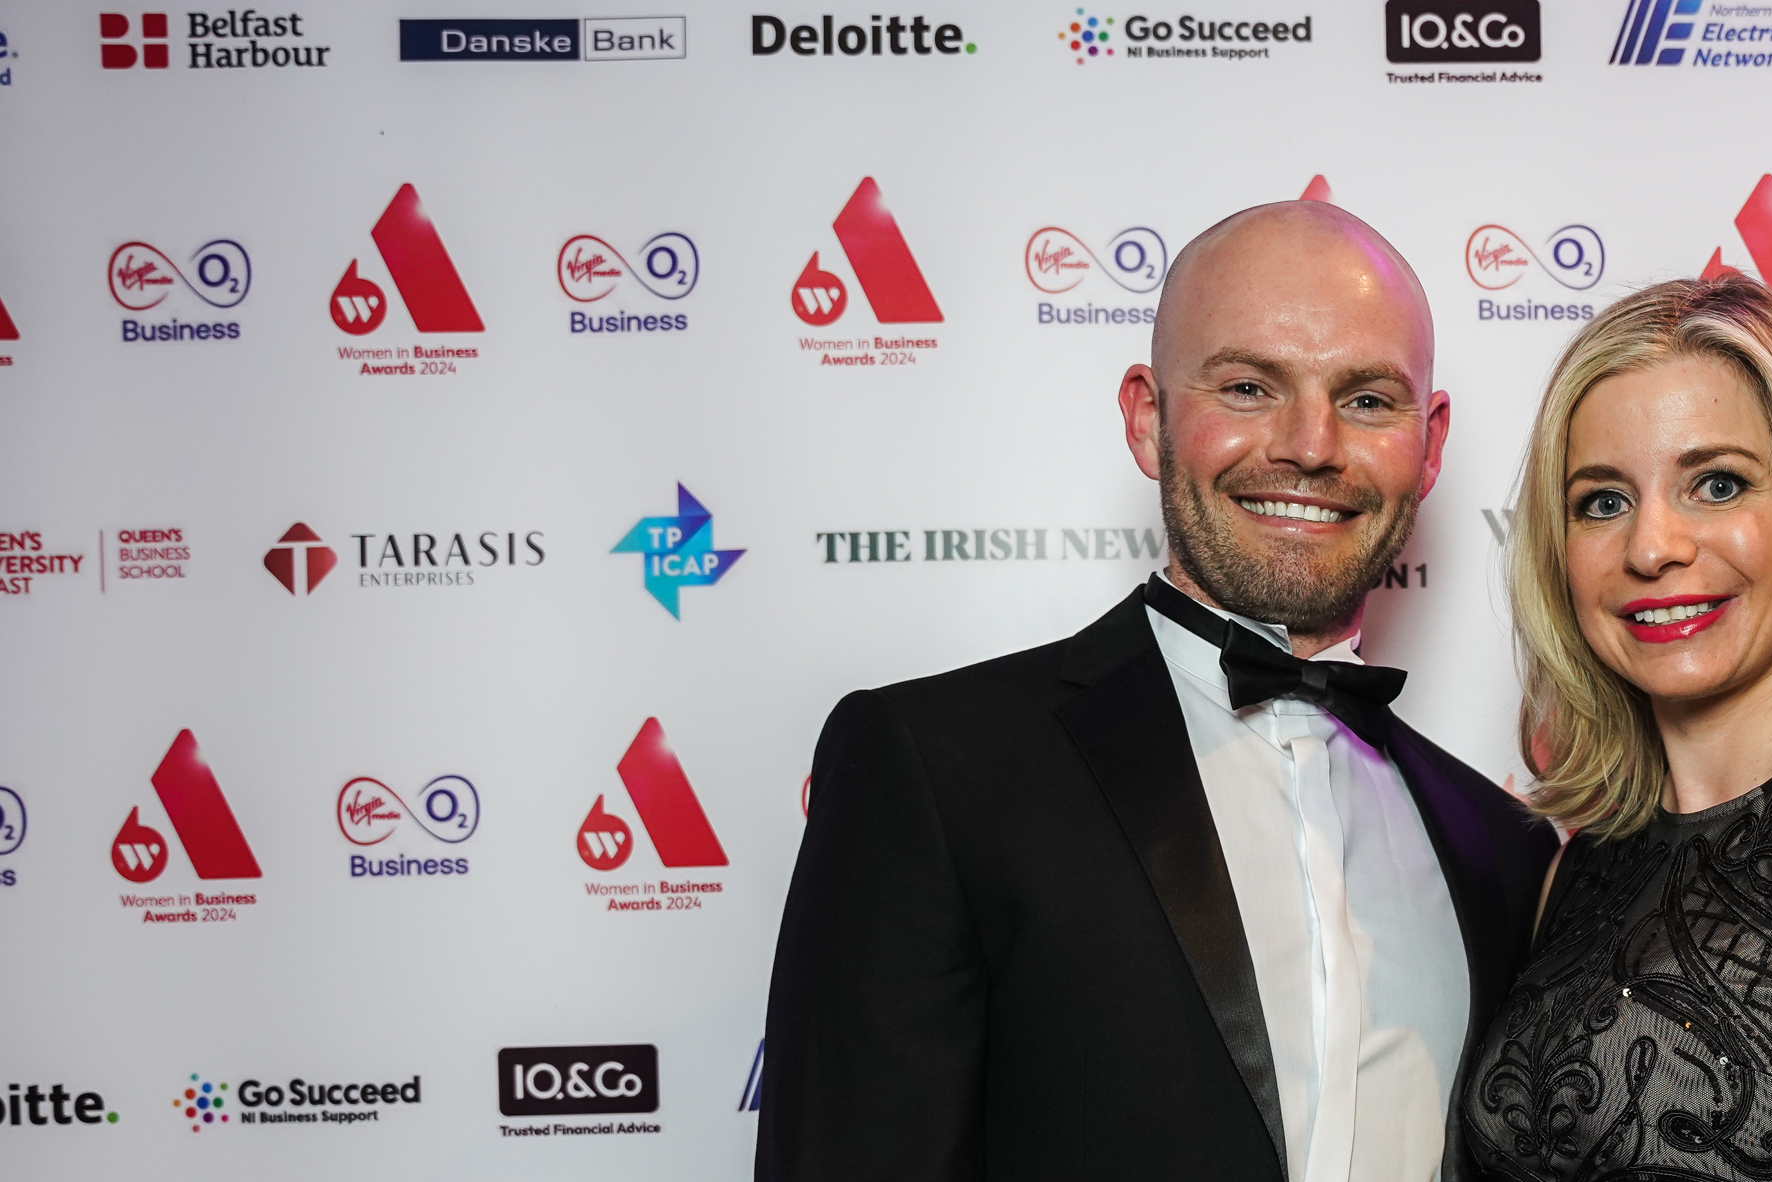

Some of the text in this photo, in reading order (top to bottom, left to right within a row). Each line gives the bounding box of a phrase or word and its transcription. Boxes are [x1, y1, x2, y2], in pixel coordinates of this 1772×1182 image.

[1709, 3, 1772, 18] Northern
[187, 9, 304, 39] Belfast
[1124, 14, 1312, 43] Go Succeed
[441, 28, 675, 53] Danske Bank
[188, 39, 331, 69] Harbour
[1127, 45, 1269, 61] NI Business Support
[1385, 71, 1543, 84] Trusted Financial Advice
[567, 246, 607, 282] Virgin
[1033, 245, 1074, 276] Virgin
[1060, 259, 1090, 270] media
[1474, 242, 1514, 272] Virgin
[1499, 256, 1529, 267] media
[118, 253, 159, 290] Virgin
[143, 275, 174, 285] media
[592, 268, 622, 278] media
[1037, 303, 1156, 325] Business
[1478, 300, 1594, 322] Business
[121, 318, 241, 343] Business
[570, 310, 688, 334] Business
[798, 336, 938, 351] Women in Business
[337, 345, 479, 360] Women in Business
[821, 351, 917, 366] Awards 2024
[360, 360, 457, 376] Awards 2024
[0, 530, 43, 552] EN'S
[117, 527, 183, 545] QUEEN'S
[648, 527, 683, 550] TP
[119, 546, 191, 562] BUSINESS
[351, 532, 545, 568] TARASIS
[816, 528, 1167, 564] THE IRISH NEW
[118, 564, 186, 580] SCHOOL
[652, 554, 720, 577] ICAP
[359, 571, 474, 588] ENTERPRISES
[346, 796, 385, 826] Virgin
[371, 810, 401, 821] media
[350, 853, 469, 878] Business
[585, 880, 723, 896] Women in Business
[119, 892, 257, 908] Women in Business
[607, 895, 702, 911] Awards 2024
[143, 907, 237, 923] Awards 2024
[237, 1075, 421, 1108] Go Succeed
[240, 1110, 379, 1125] NI Business Support
[499, 1122, 662, 1137] Trusted Financial Advice
